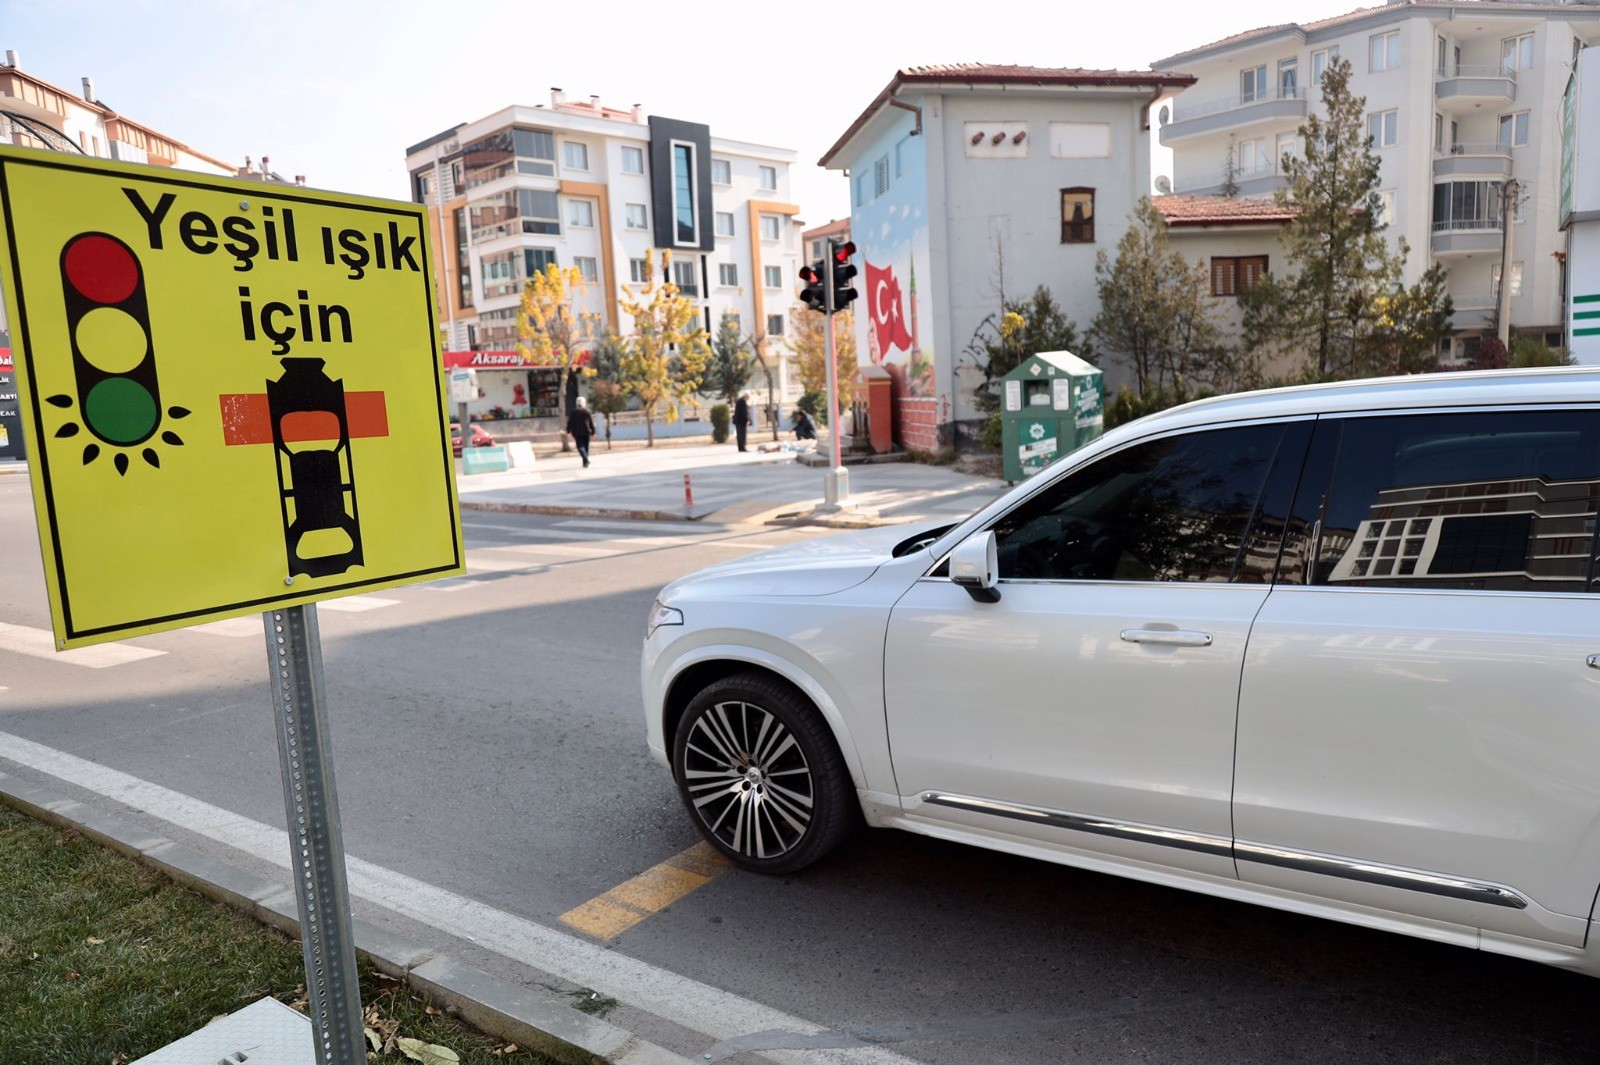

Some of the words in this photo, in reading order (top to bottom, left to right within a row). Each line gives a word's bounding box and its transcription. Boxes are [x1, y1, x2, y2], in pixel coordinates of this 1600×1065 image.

[121, 187, 299, 272] Yeşil
[321, 221, 421, 280] ışık
[238, 286, 353, 355] için
[471, 353, 524, 366] Aksaray
